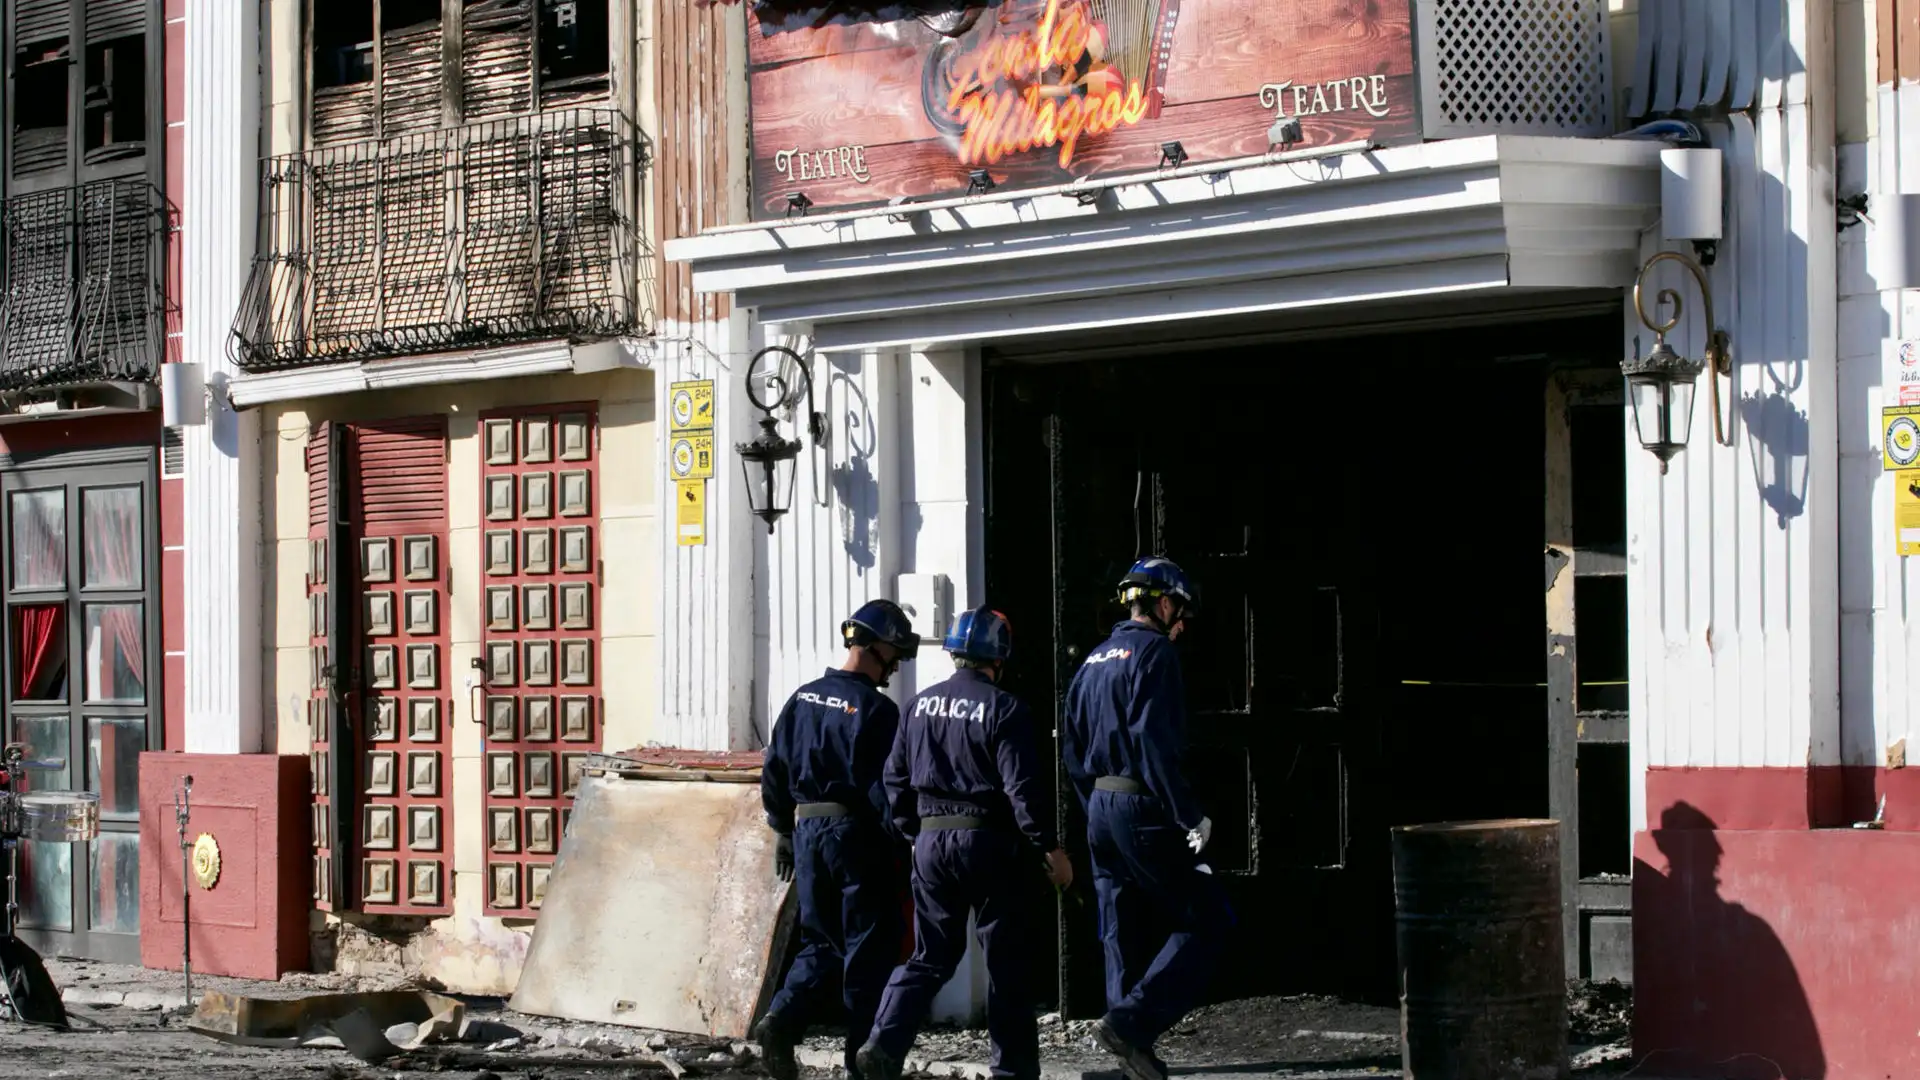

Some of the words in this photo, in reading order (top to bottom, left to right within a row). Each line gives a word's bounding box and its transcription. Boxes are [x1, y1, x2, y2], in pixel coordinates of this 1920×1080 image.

[1259, 74, 1391, 118] TEATRE
[957, 76, 1151, 169] Milagros
[775, 145, 871, 184] TEATRE
[695, 388, 712, 400] 24H
[695, 438, 713, 450] 24H
